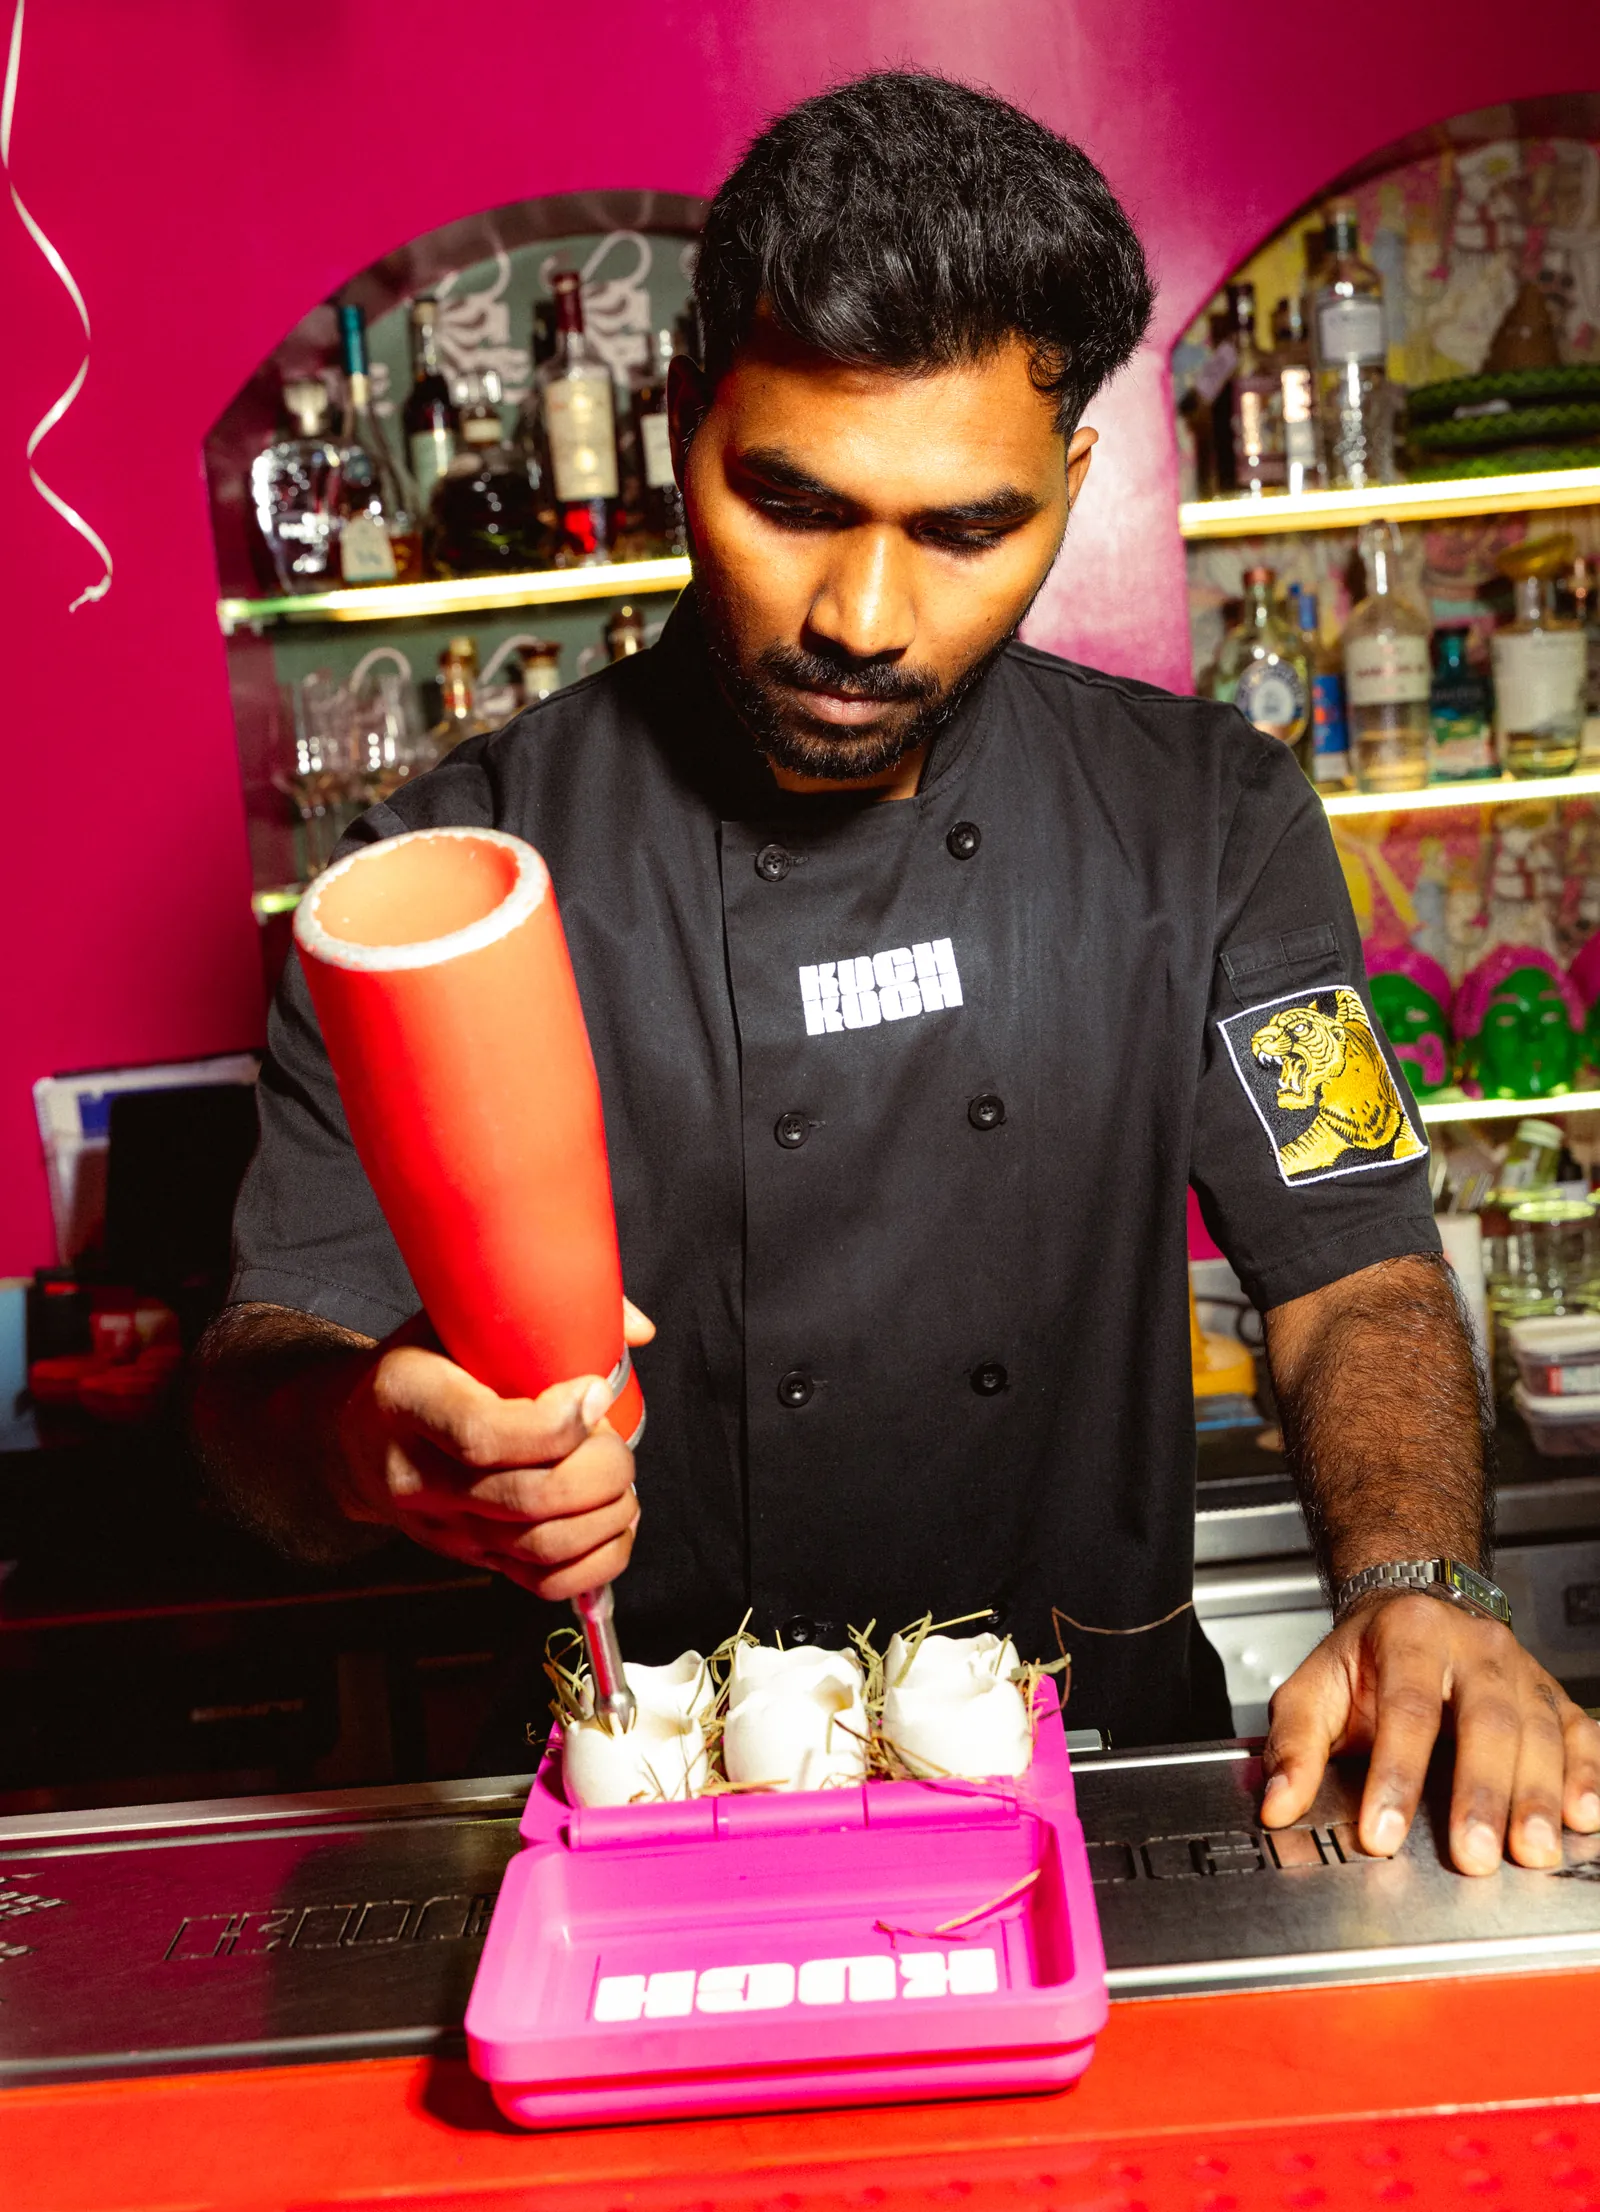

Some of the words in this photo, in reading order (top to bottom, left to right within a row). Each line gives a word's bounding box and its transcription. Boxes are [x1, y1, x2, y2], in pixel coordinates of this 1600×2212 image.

[799, 938, 958, 1002] KUCH
[803, 972, 963, 1036] KUCH
[594, 1948, 998, 2022] KUCH
